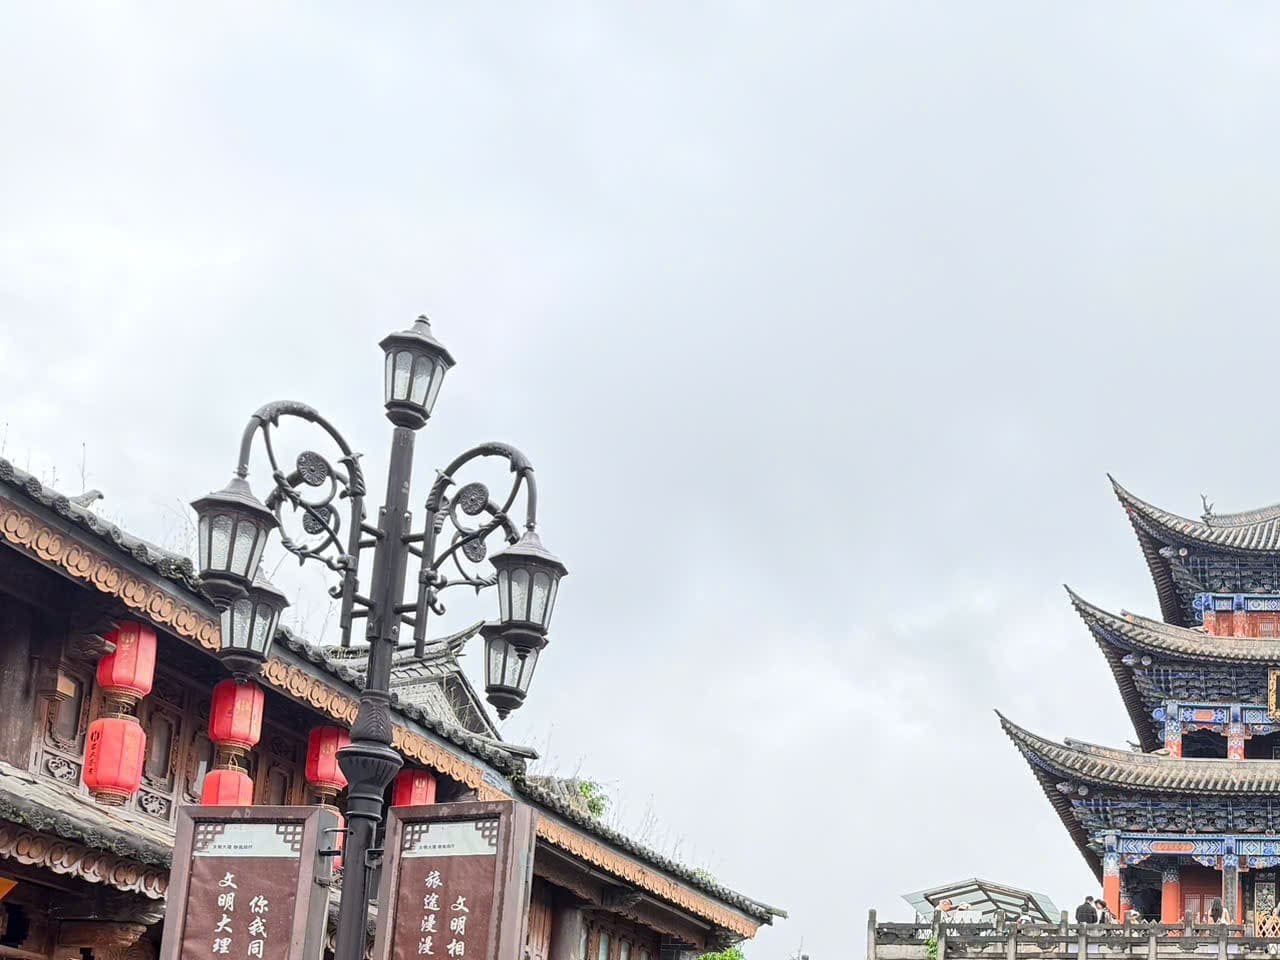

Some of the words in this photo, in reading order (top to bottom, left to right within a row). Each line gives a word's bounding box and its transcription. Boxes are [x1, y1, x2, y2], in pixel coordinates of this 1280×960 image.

[212, 871, 238, 954] 文明大理
[418, 870, 443, 955] 旅途漫漫
